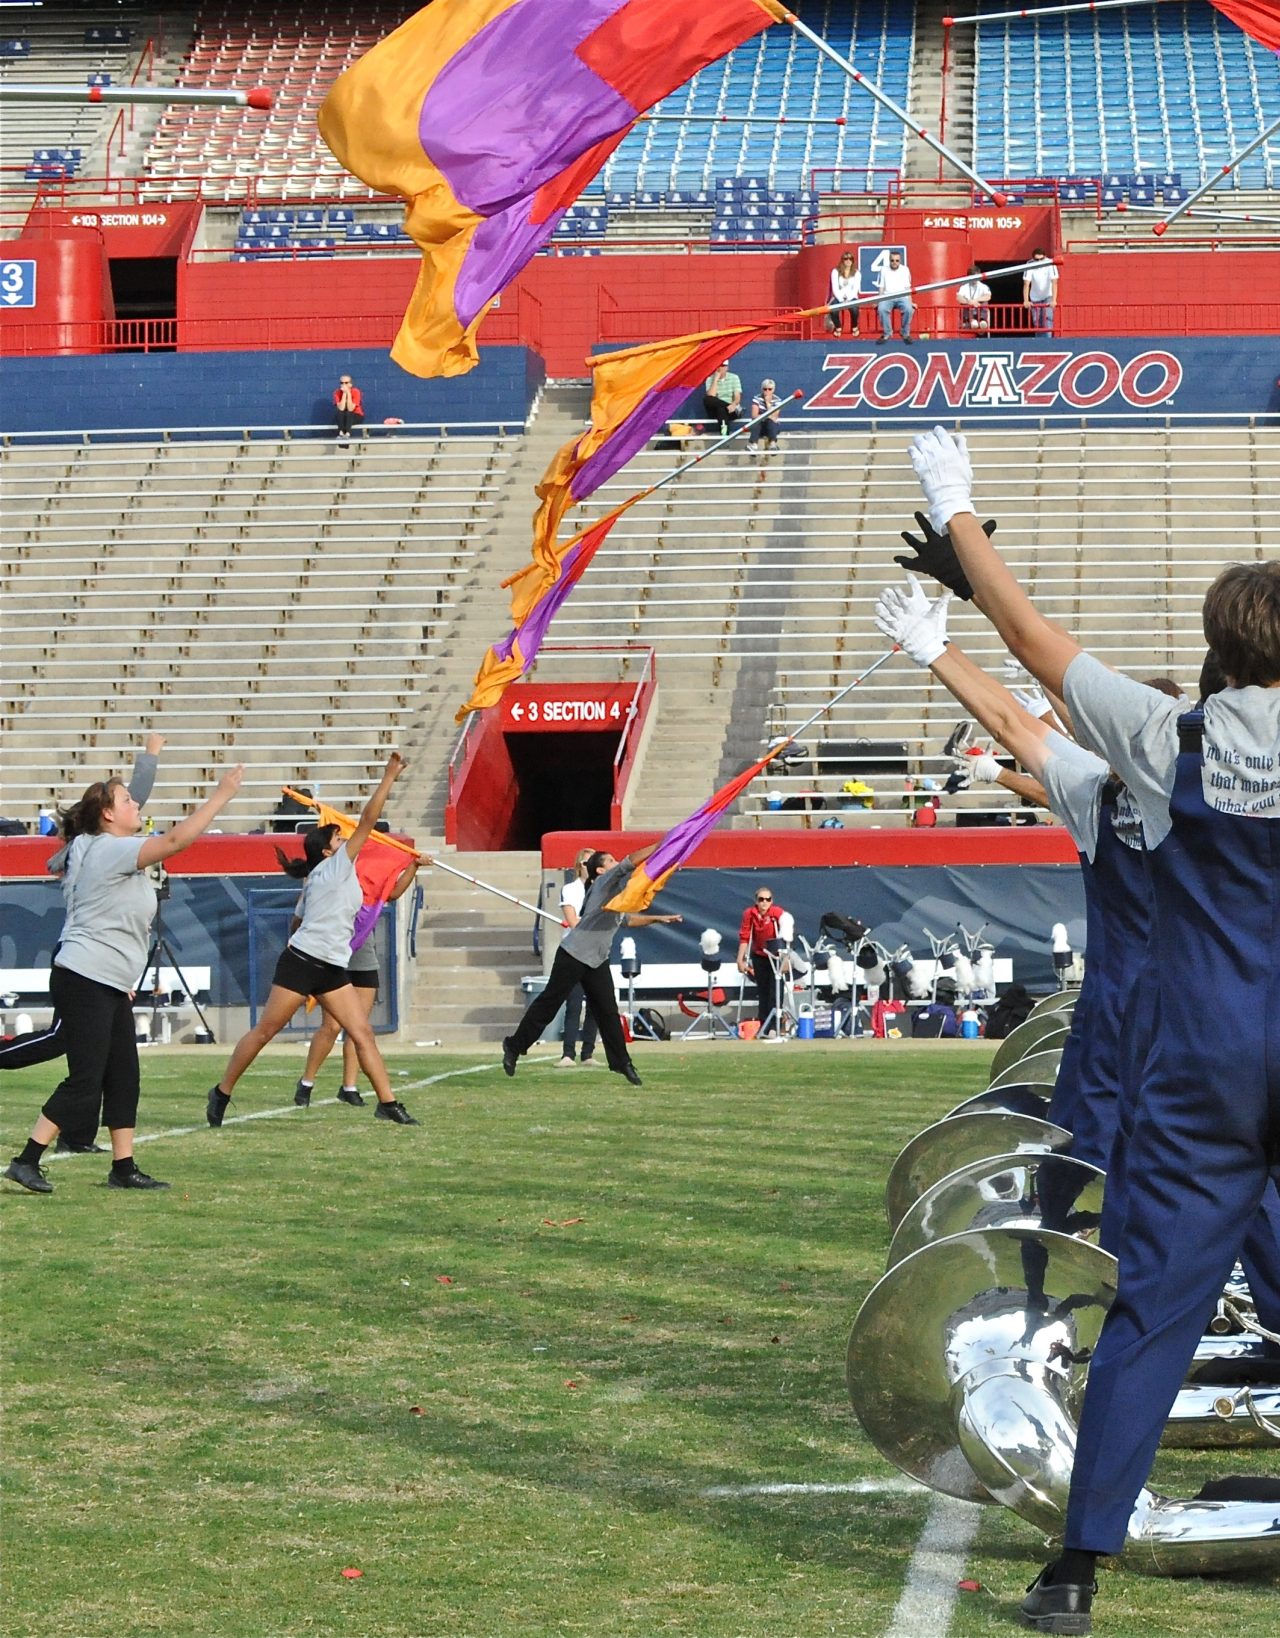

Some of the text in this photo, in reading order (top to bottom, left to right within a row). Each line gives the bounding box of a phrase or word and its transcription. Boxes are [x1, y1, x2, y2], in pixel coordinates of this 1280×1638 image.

[81, 214, 158, 226] 103 SECTION 104
[934, 218, 949, 228] 104
[996, 216, 1012, 229] 105
[1, 263, 24, 292] 3
[803, 351, 1183, 410] ZONAZOO
[528, 701, 620, 721] 3 SECTION 4
[1245, 755, 1274, 772] only
[1210, 771, 1237, 790] that
[1215, 796, 1247, 813] what
[1251, 795, 1275, 813] you
